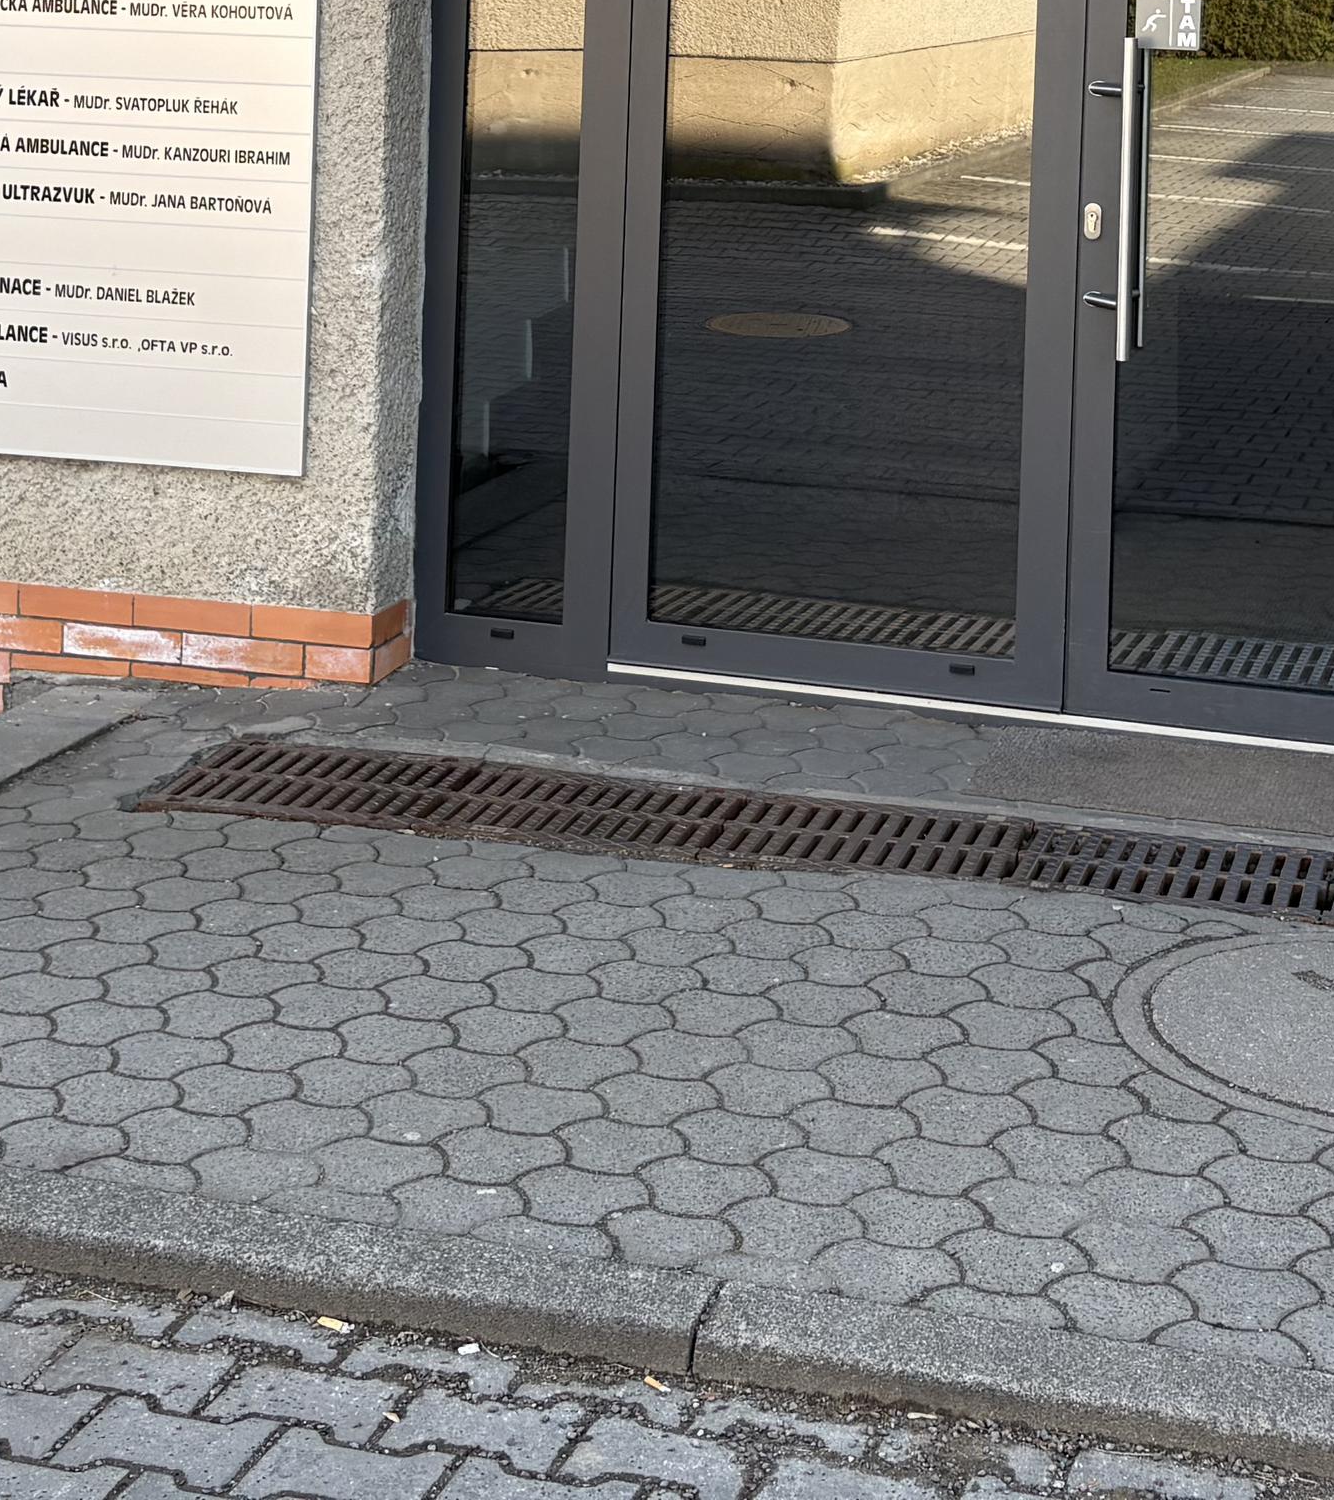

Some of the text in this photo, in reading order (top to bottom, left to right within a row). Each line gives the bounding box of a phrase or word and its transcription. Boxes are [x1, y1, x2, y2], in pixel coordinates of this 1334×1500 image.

[129, 2, 167, 17] MUDr.
[173, 2, 207, 18] VĚRA
[211, 4, 293, 20] KOHOUTOVÁ
[9, 86, 59, 107] LÉKAŘ
[74, 95, 111, 110] MUDr.
[115, 96, 189, 112] SVATOPLUK
[194, 97, 238, 115] ŘEHÁK
[15, 138, 109, 156] AMBULANCE
[122, 144, 159, 160] MUDr.
[165, 147, 230, 162] KANZOURI
[235, 150, 291, 166] IBRAHIM
[2, 184, 95, 204] ULTRAZVUK
[109, 191, 147, 207] MUDr.
[151, 194, 185, 209] JANA
[191, 196, 271, 214] BARTOŇOVÁ
[55, 284, 92, 300] MUDr.
[97, 286, 142, 302] DANIEL
[147, 288, 195, 306] BLAŽEK
[62, 332, 98, 346] VISUS
[101, 337, 131, 349] s.r.o.
[181, 342, 197, 353] VP
[201, 344, 233, 356] s.r.o.
